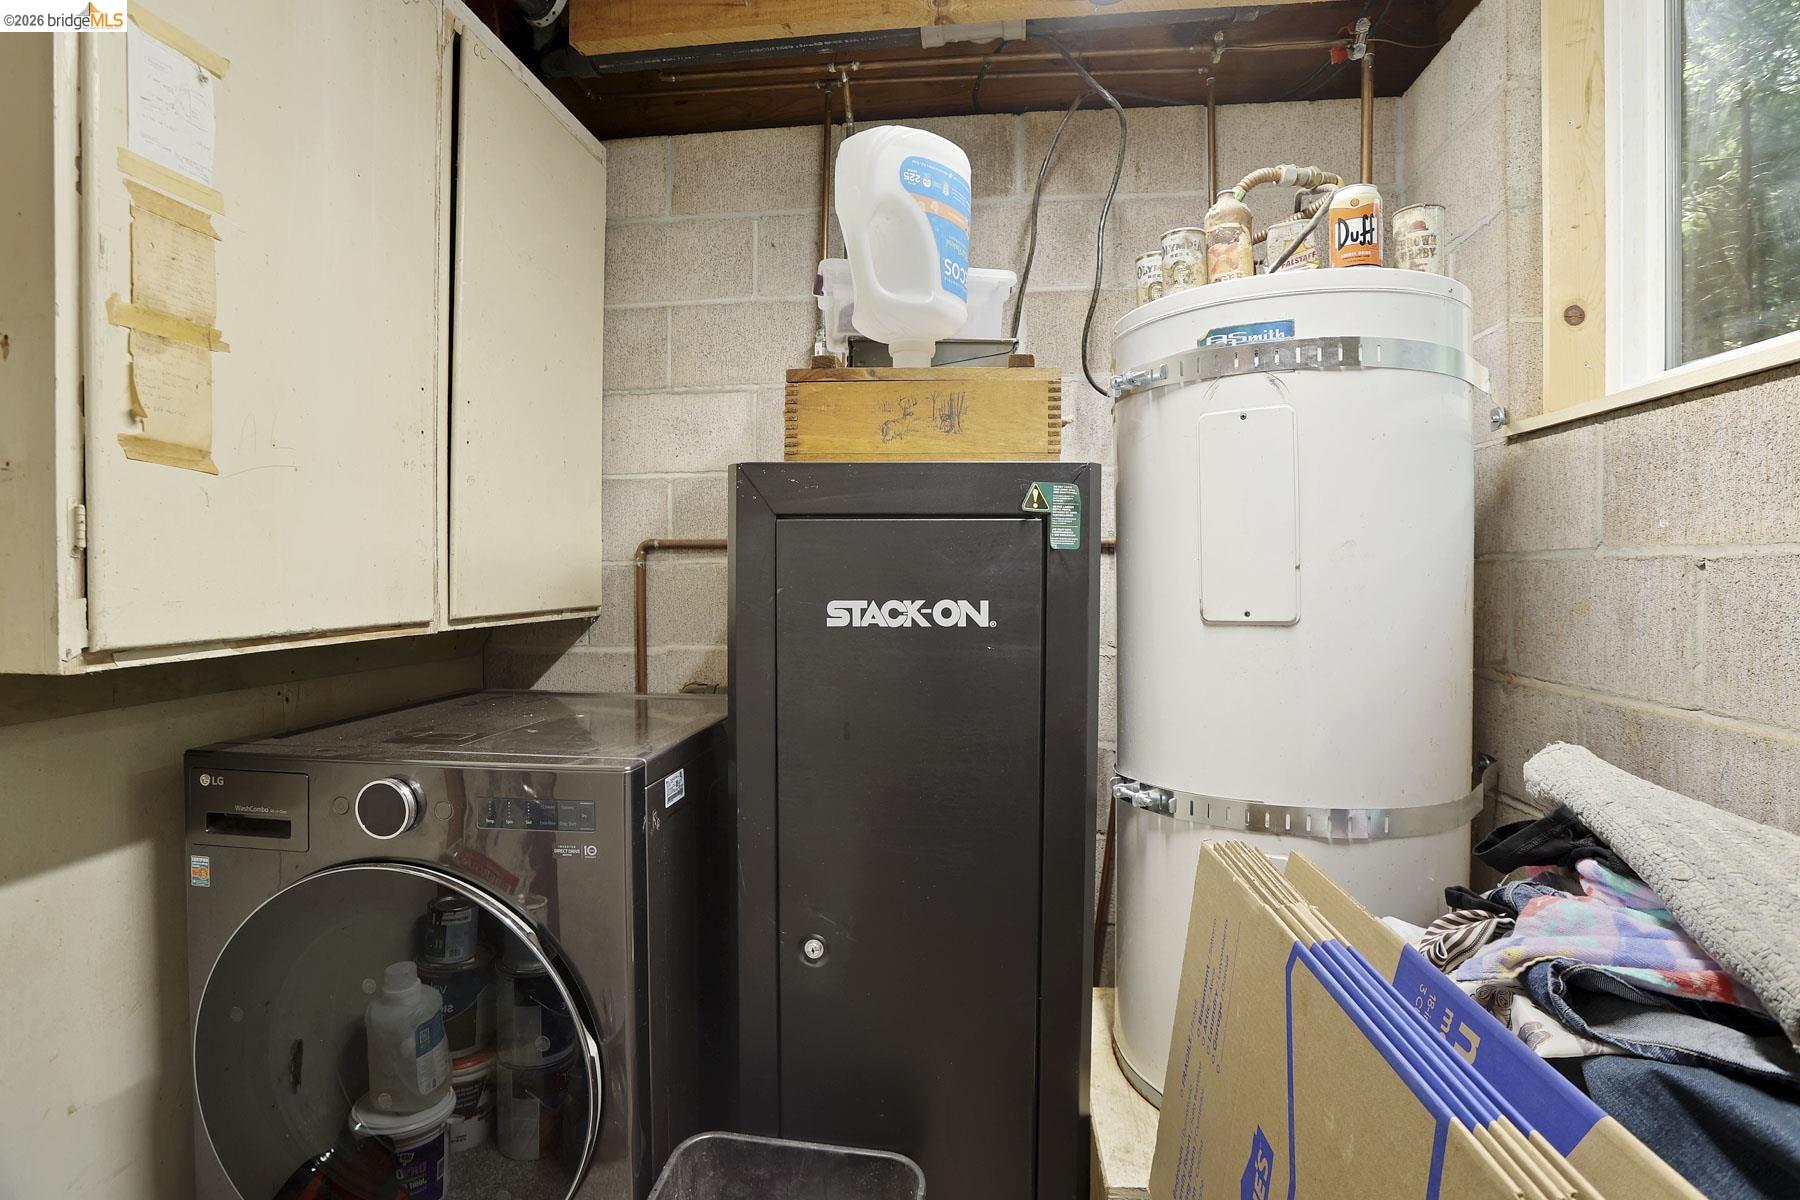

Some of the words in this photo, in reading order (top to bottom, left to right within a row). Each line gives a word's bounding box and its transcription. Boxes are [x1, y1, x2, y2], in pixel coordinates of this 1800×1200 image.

[903, 171, 921, 183] 225
[1337, 213, 1375, 251] Duff
[1281, 251, 1317, 269] FALSTAFF
[826, 599, 990, 628] STACK-ON
[211, 776, 225, 786] LG
[235, 803, 269, 813] WashCombo
[1419, 983, 1428, 996] 3
[1207, 989, 1219, 1043] Laundry
[1212, 1001, 1223, 1051] Garage
